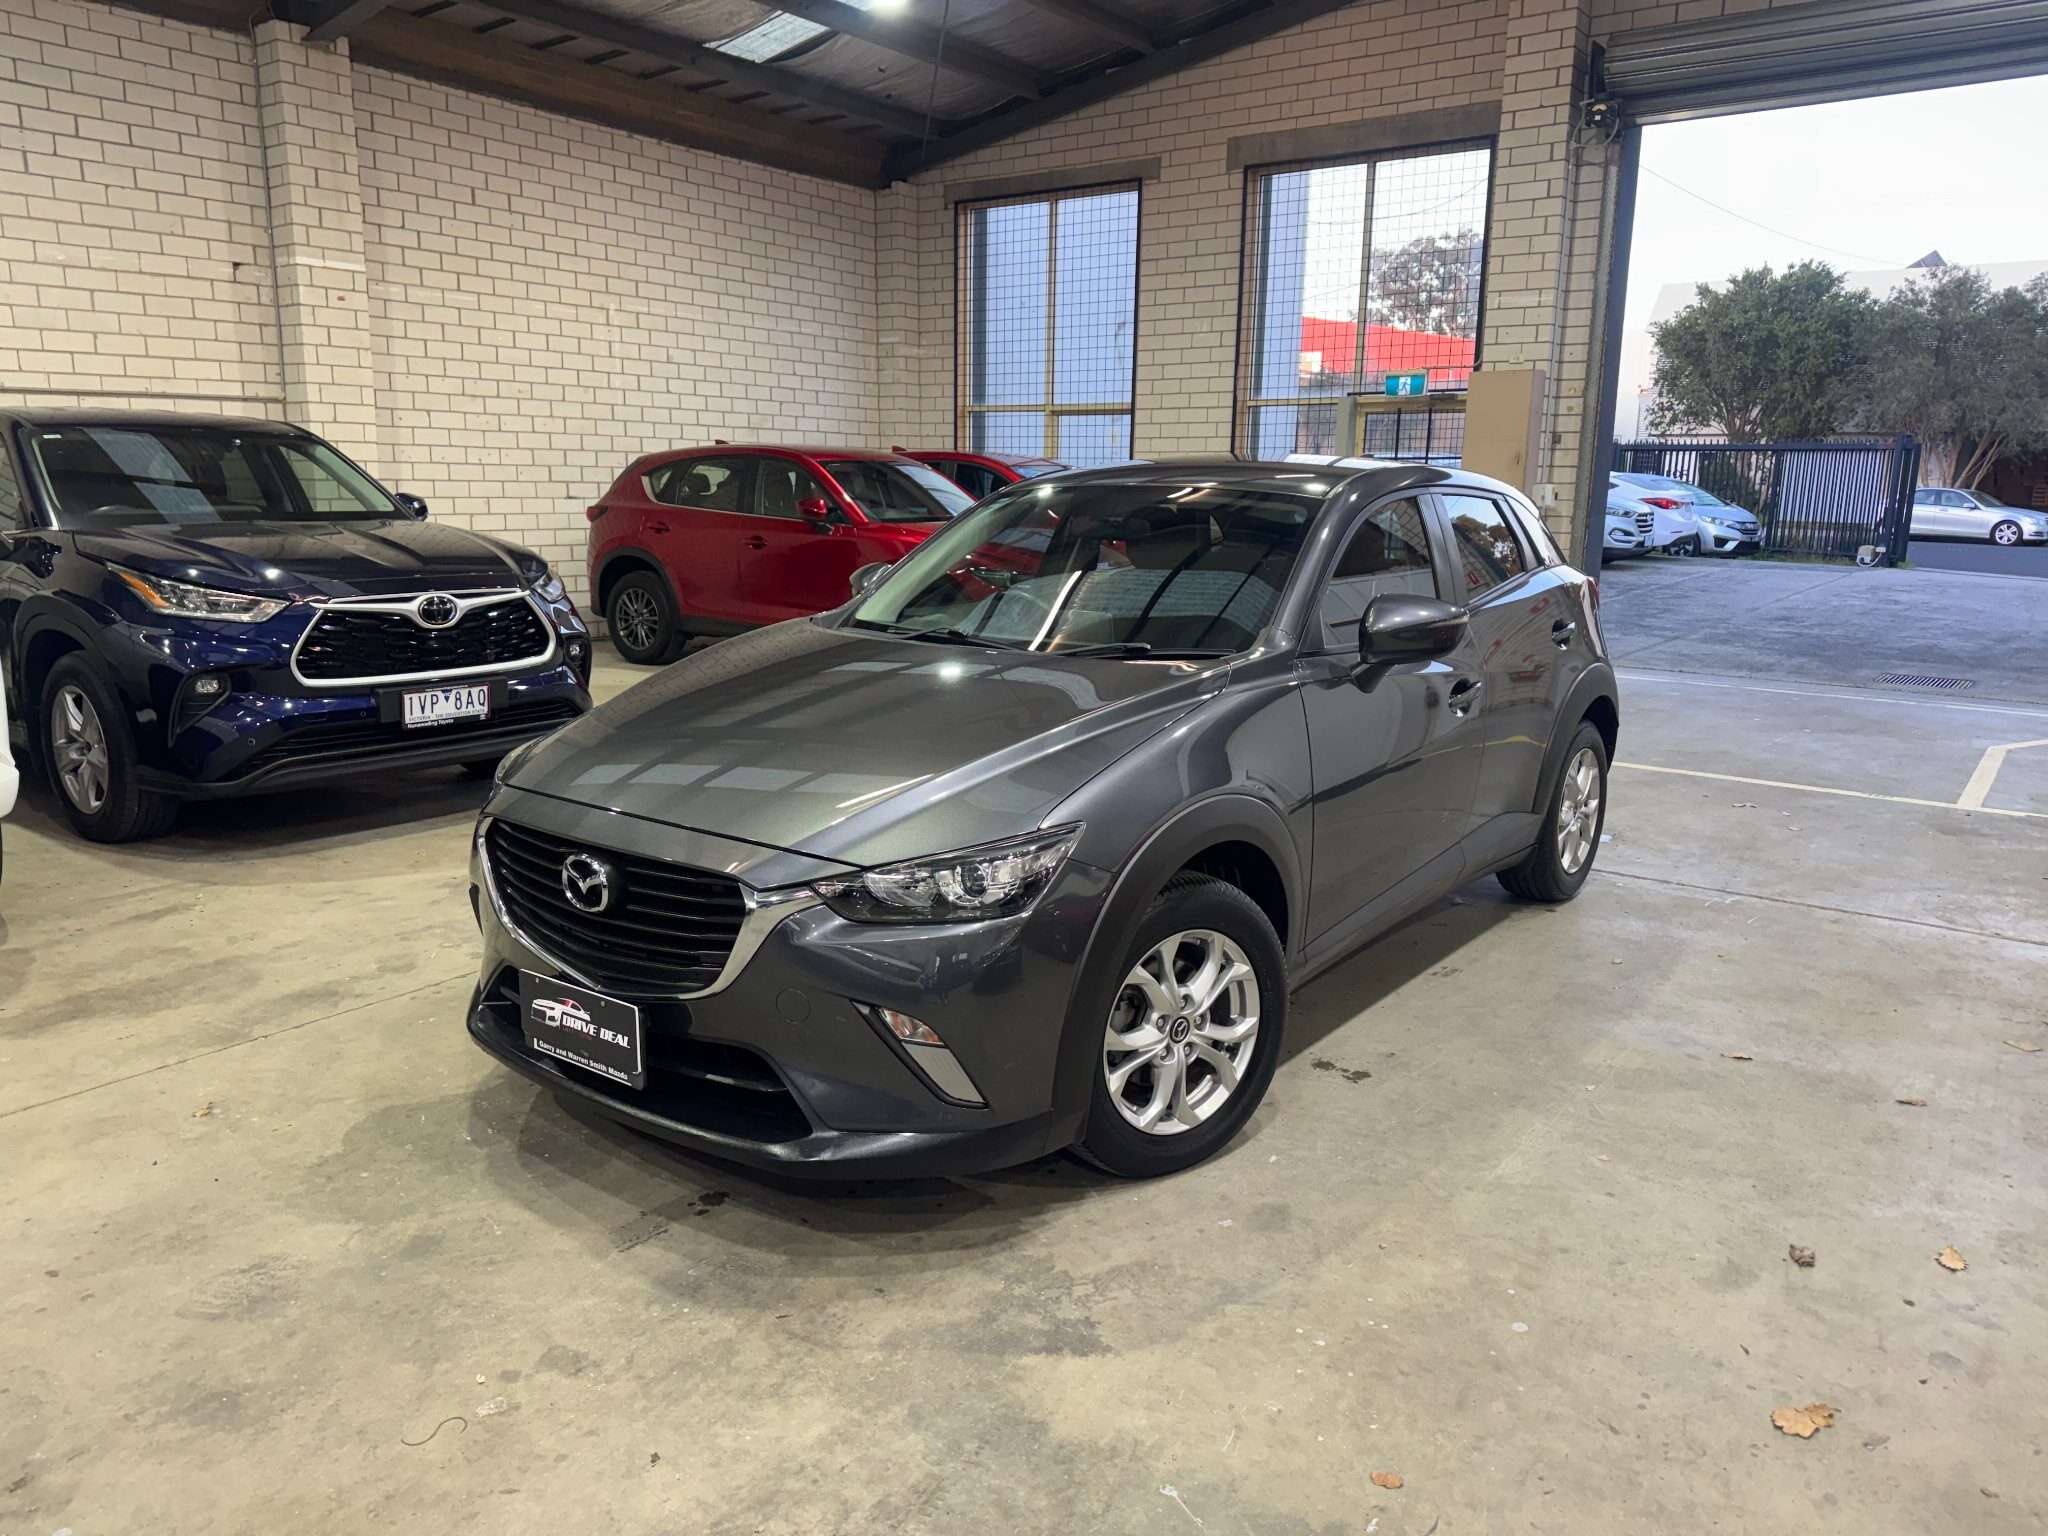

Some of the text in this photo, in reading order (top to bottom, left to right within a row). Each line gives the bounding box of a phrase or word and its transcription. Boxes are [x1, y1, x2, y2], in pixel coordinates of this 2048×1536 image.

[408, 688, 486, 716] 1VP 8AQ
[445, 710, 471, 718] EDUCATION
[438, 718, 454, 726] Toyota
[561, 1015, 598, 1037] DRIVE
[599, 1027, 631, 1049] DEAL
[555, 1047, 567, 1057] and
[567, 1050, 589, 1065] Warren
[589, 1059, 608, 1072] Smith
[608, 1066, 629, 1080] Mazda
